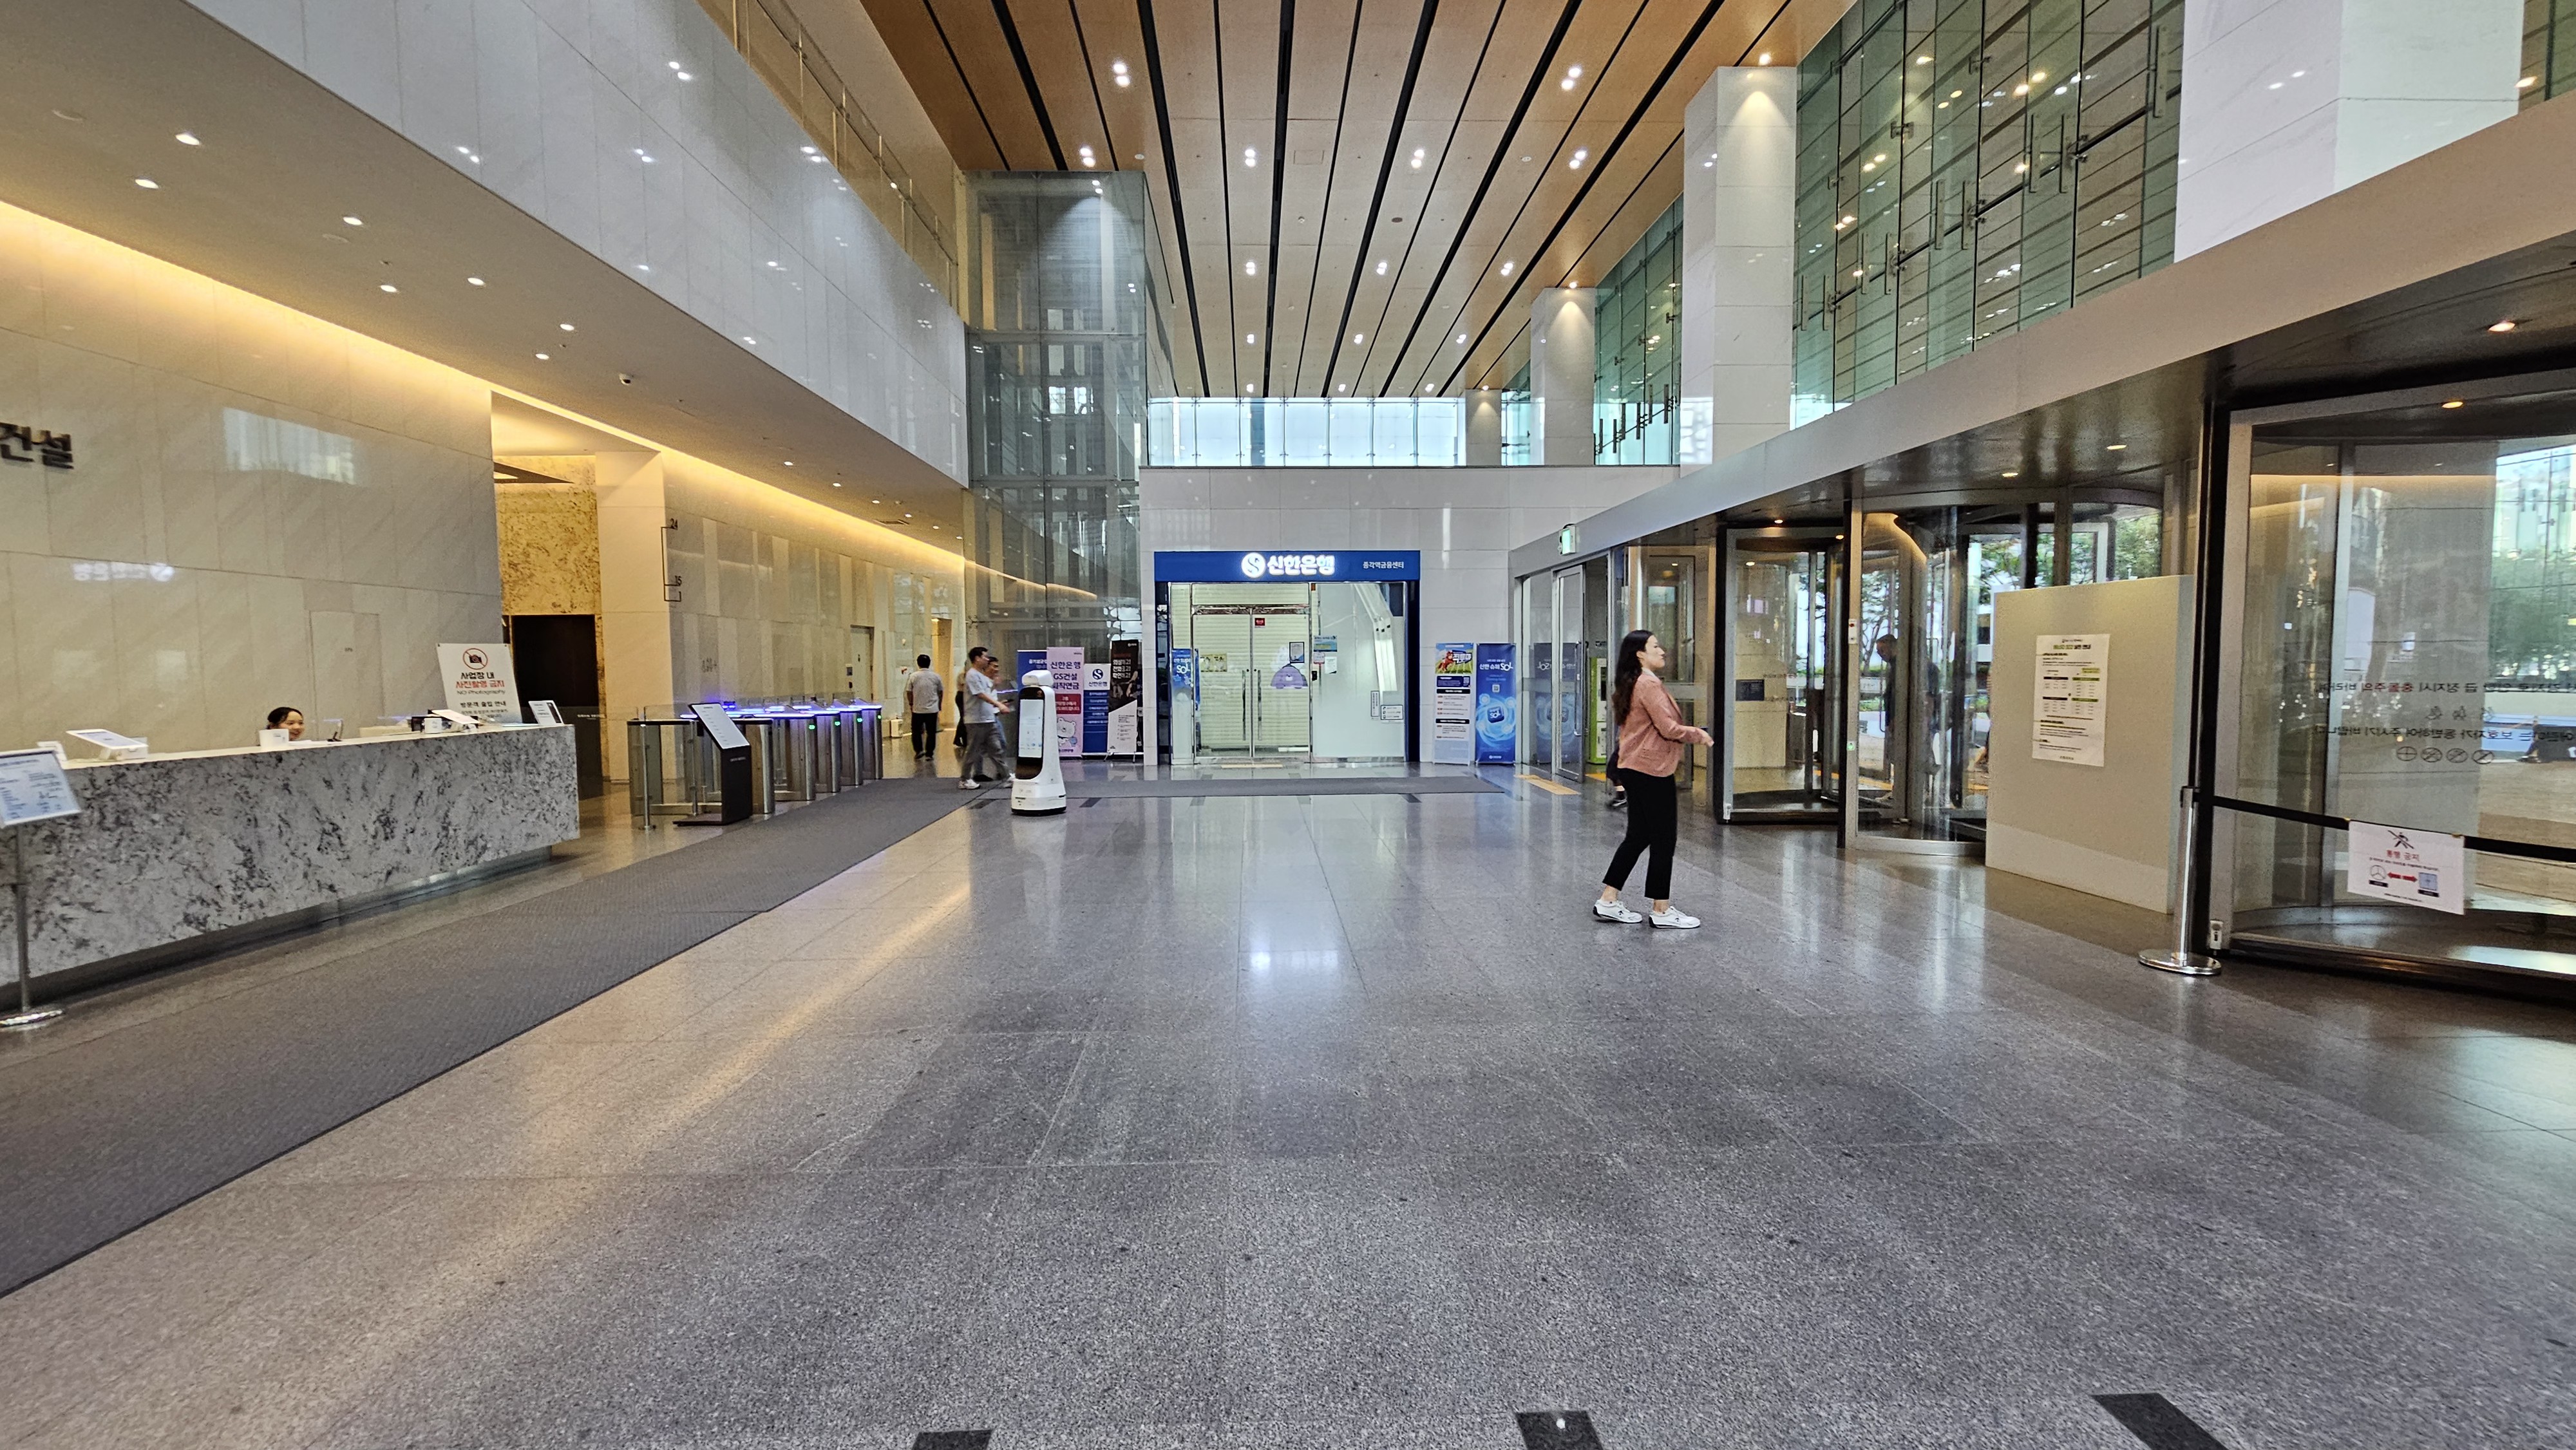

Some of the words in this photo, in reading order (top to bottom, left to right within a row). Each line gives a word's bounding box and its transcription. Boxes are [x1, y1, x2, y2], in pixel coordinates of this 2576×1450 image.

[670, 518, 678, 531] 24
[1267, 555, 1335, 576] 신한은행
[1363, 561, 1405, 569] 종각역금융센터
[674, 575, 683, 587] 15
[1050, 661, 1081, 670] 신한은행
[460, 672, 484, 680] 사업장
[455, 680, 488, 688] 사진촬영
[2403, 852, 2420, 862] 금지
